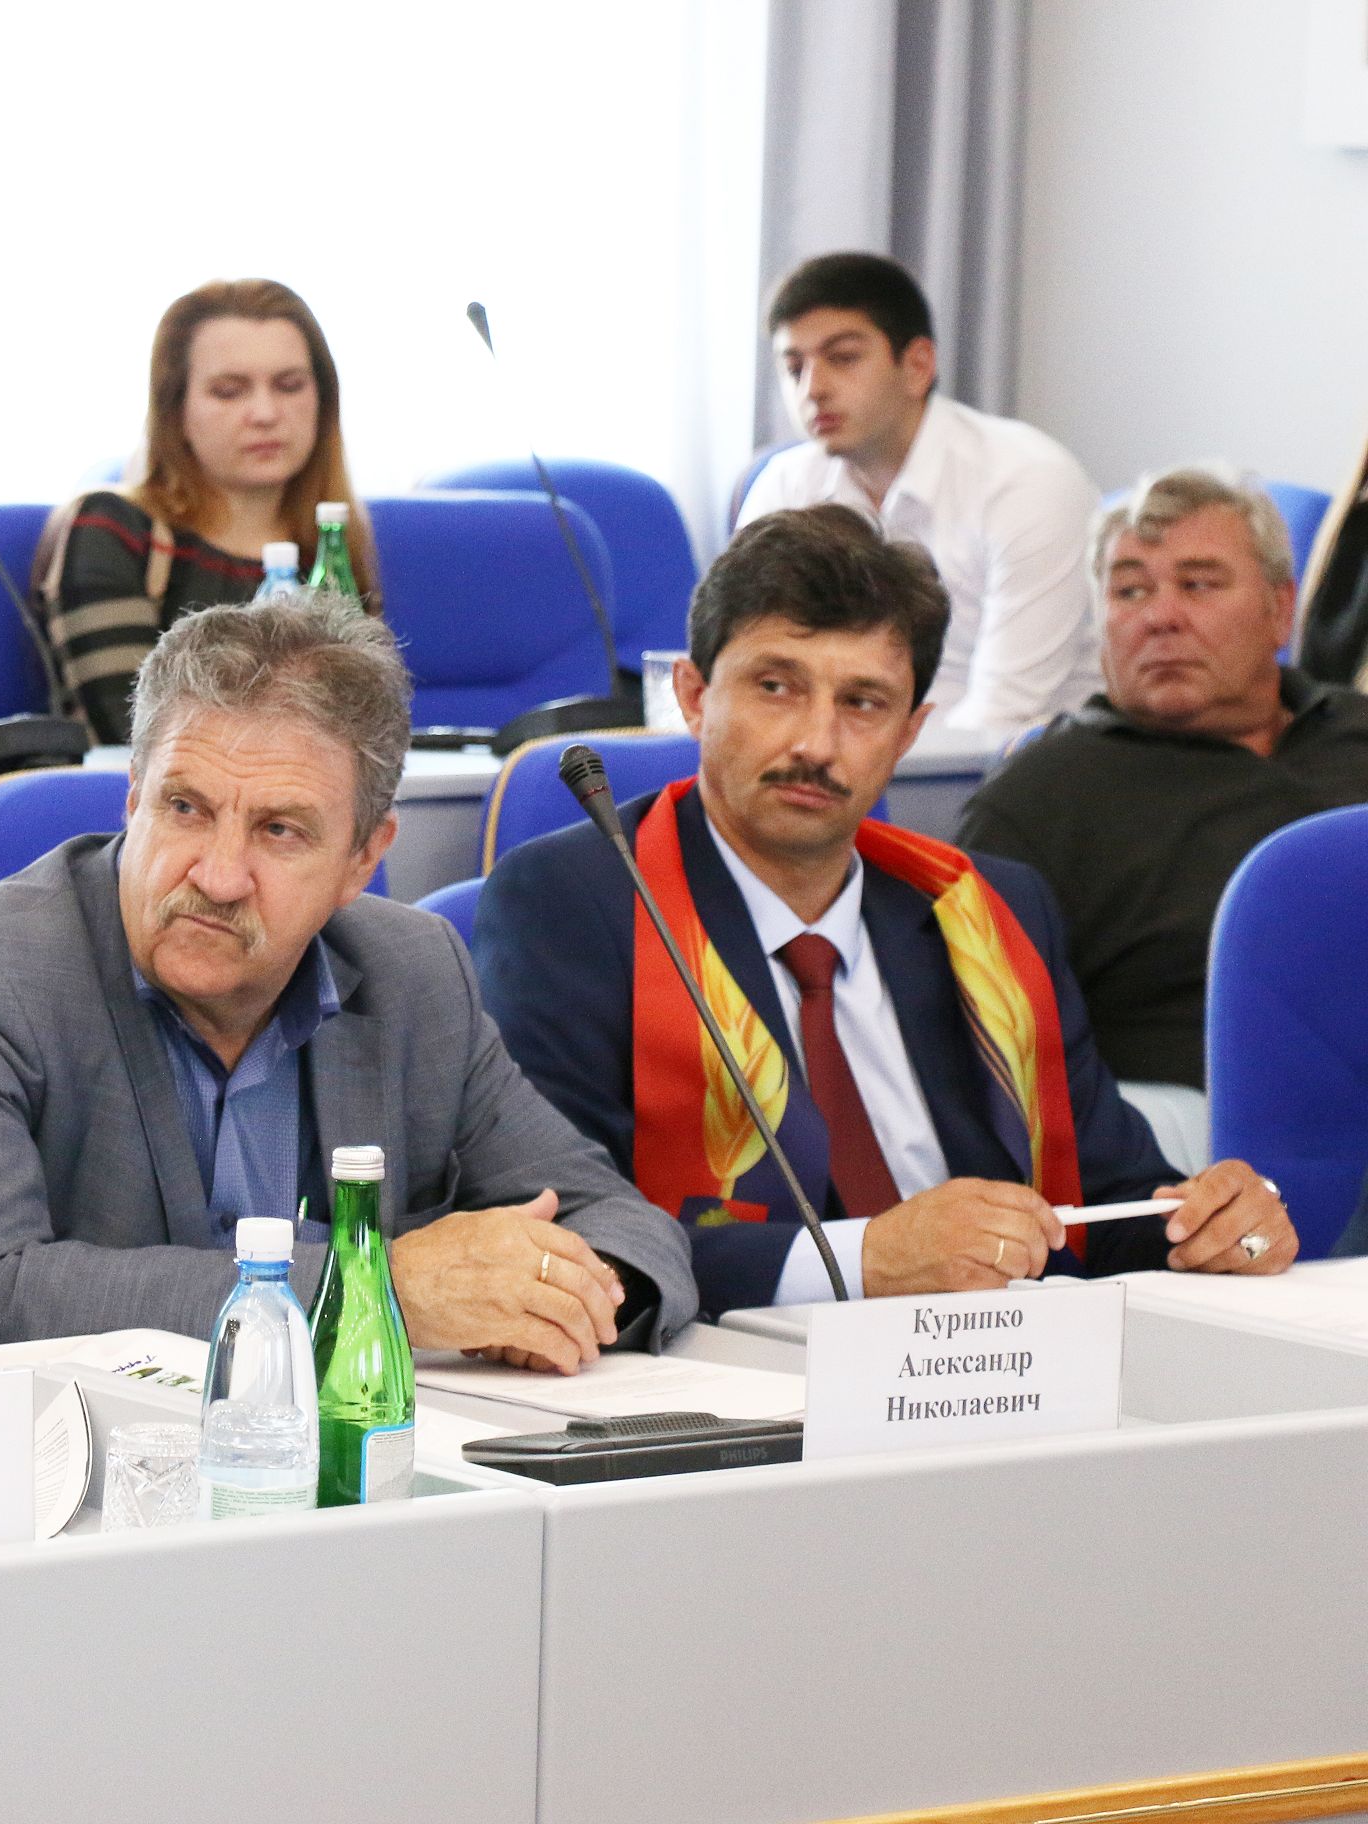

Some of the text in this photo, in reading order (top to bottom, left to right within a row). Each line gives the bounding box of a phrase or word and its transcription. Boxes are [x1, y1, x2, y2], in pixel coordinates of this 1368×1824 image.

[913, 1308, 1024, 1340] Курипко
[898, 1351, 1033, 1378] Александр
[886, 1393, 1041, 1422] Николаевич
[720, 1447, 768, 1463] PHILIPS
